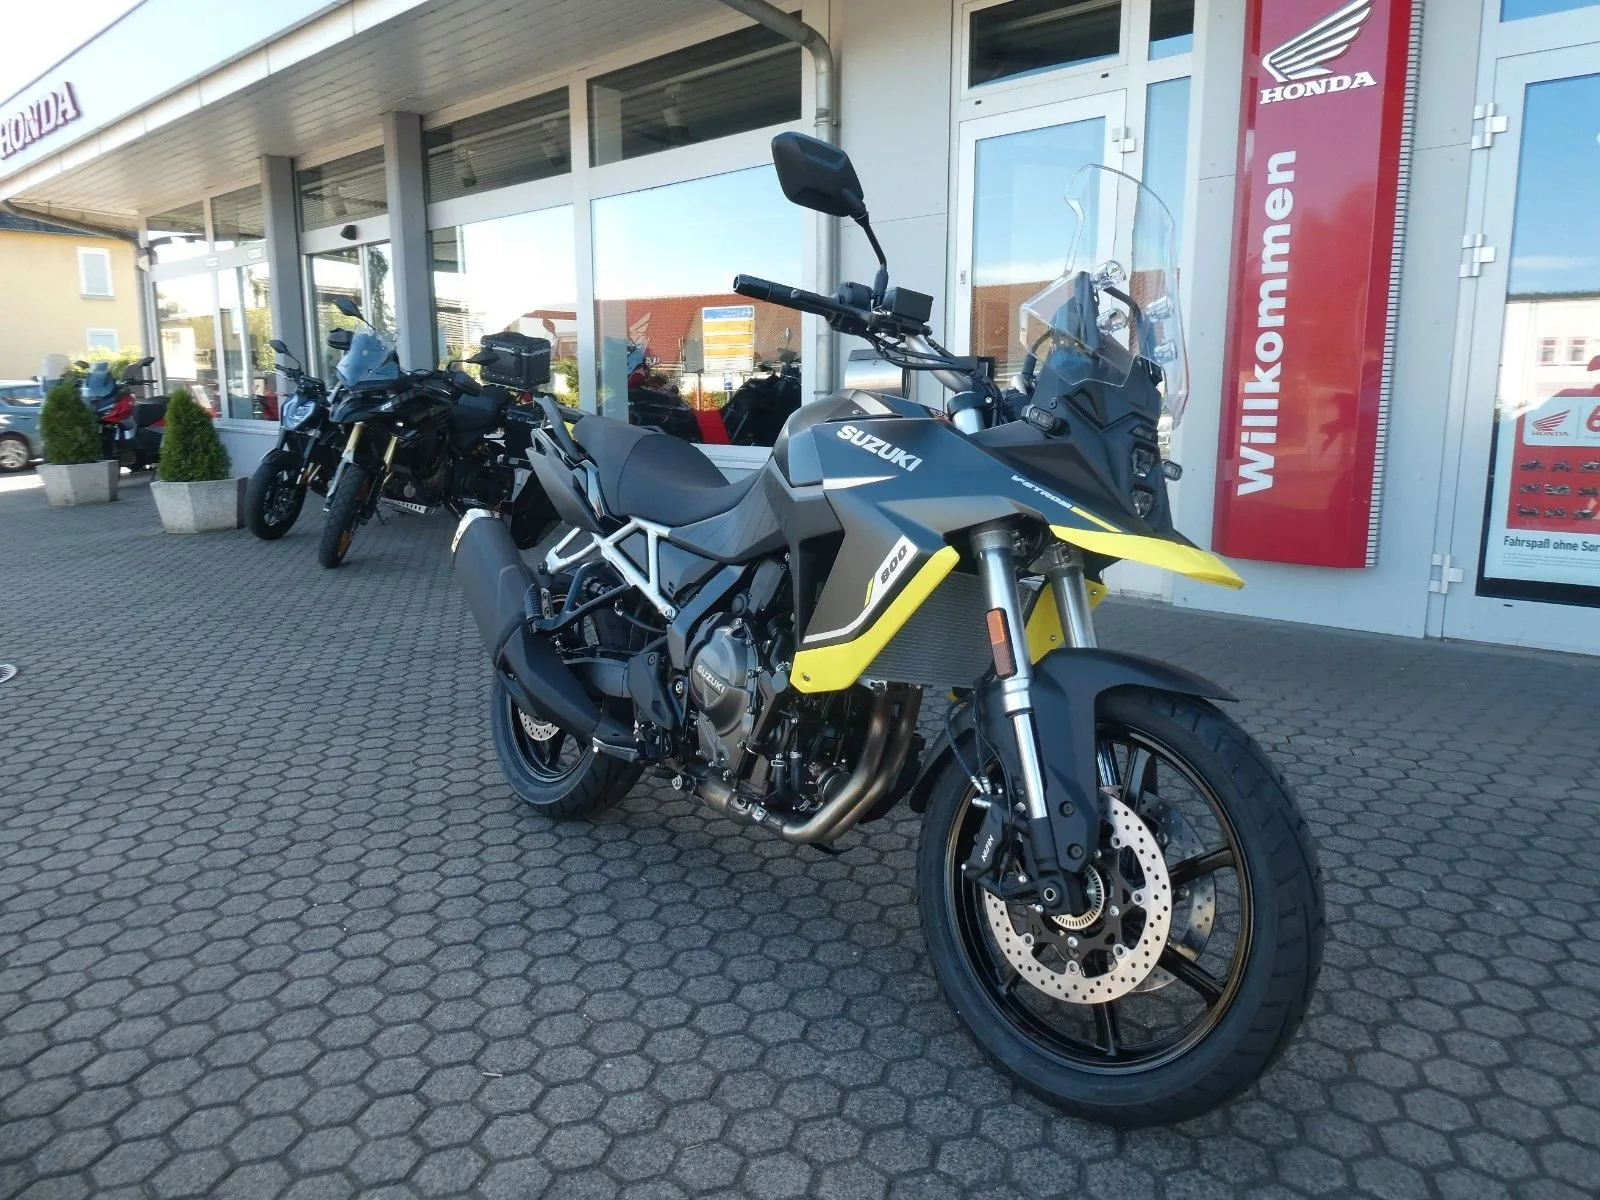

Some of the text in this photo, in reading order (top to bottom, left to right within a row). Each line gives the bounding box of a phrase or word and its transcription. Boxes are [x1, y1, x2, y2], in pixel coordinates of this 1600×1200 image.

[1259, 71, 1378, 105] HONDA
[1237, 150, 1297, 497] Willkommen
[836, 425, 923, 472] SUZUKI
[1503, 535, 1551, 550] Fahrspaß
[1553, 540, 1579, 551] ohne
[881, 544, 907, 585] 800
[697, 664, 726, 693] SUZUKI
